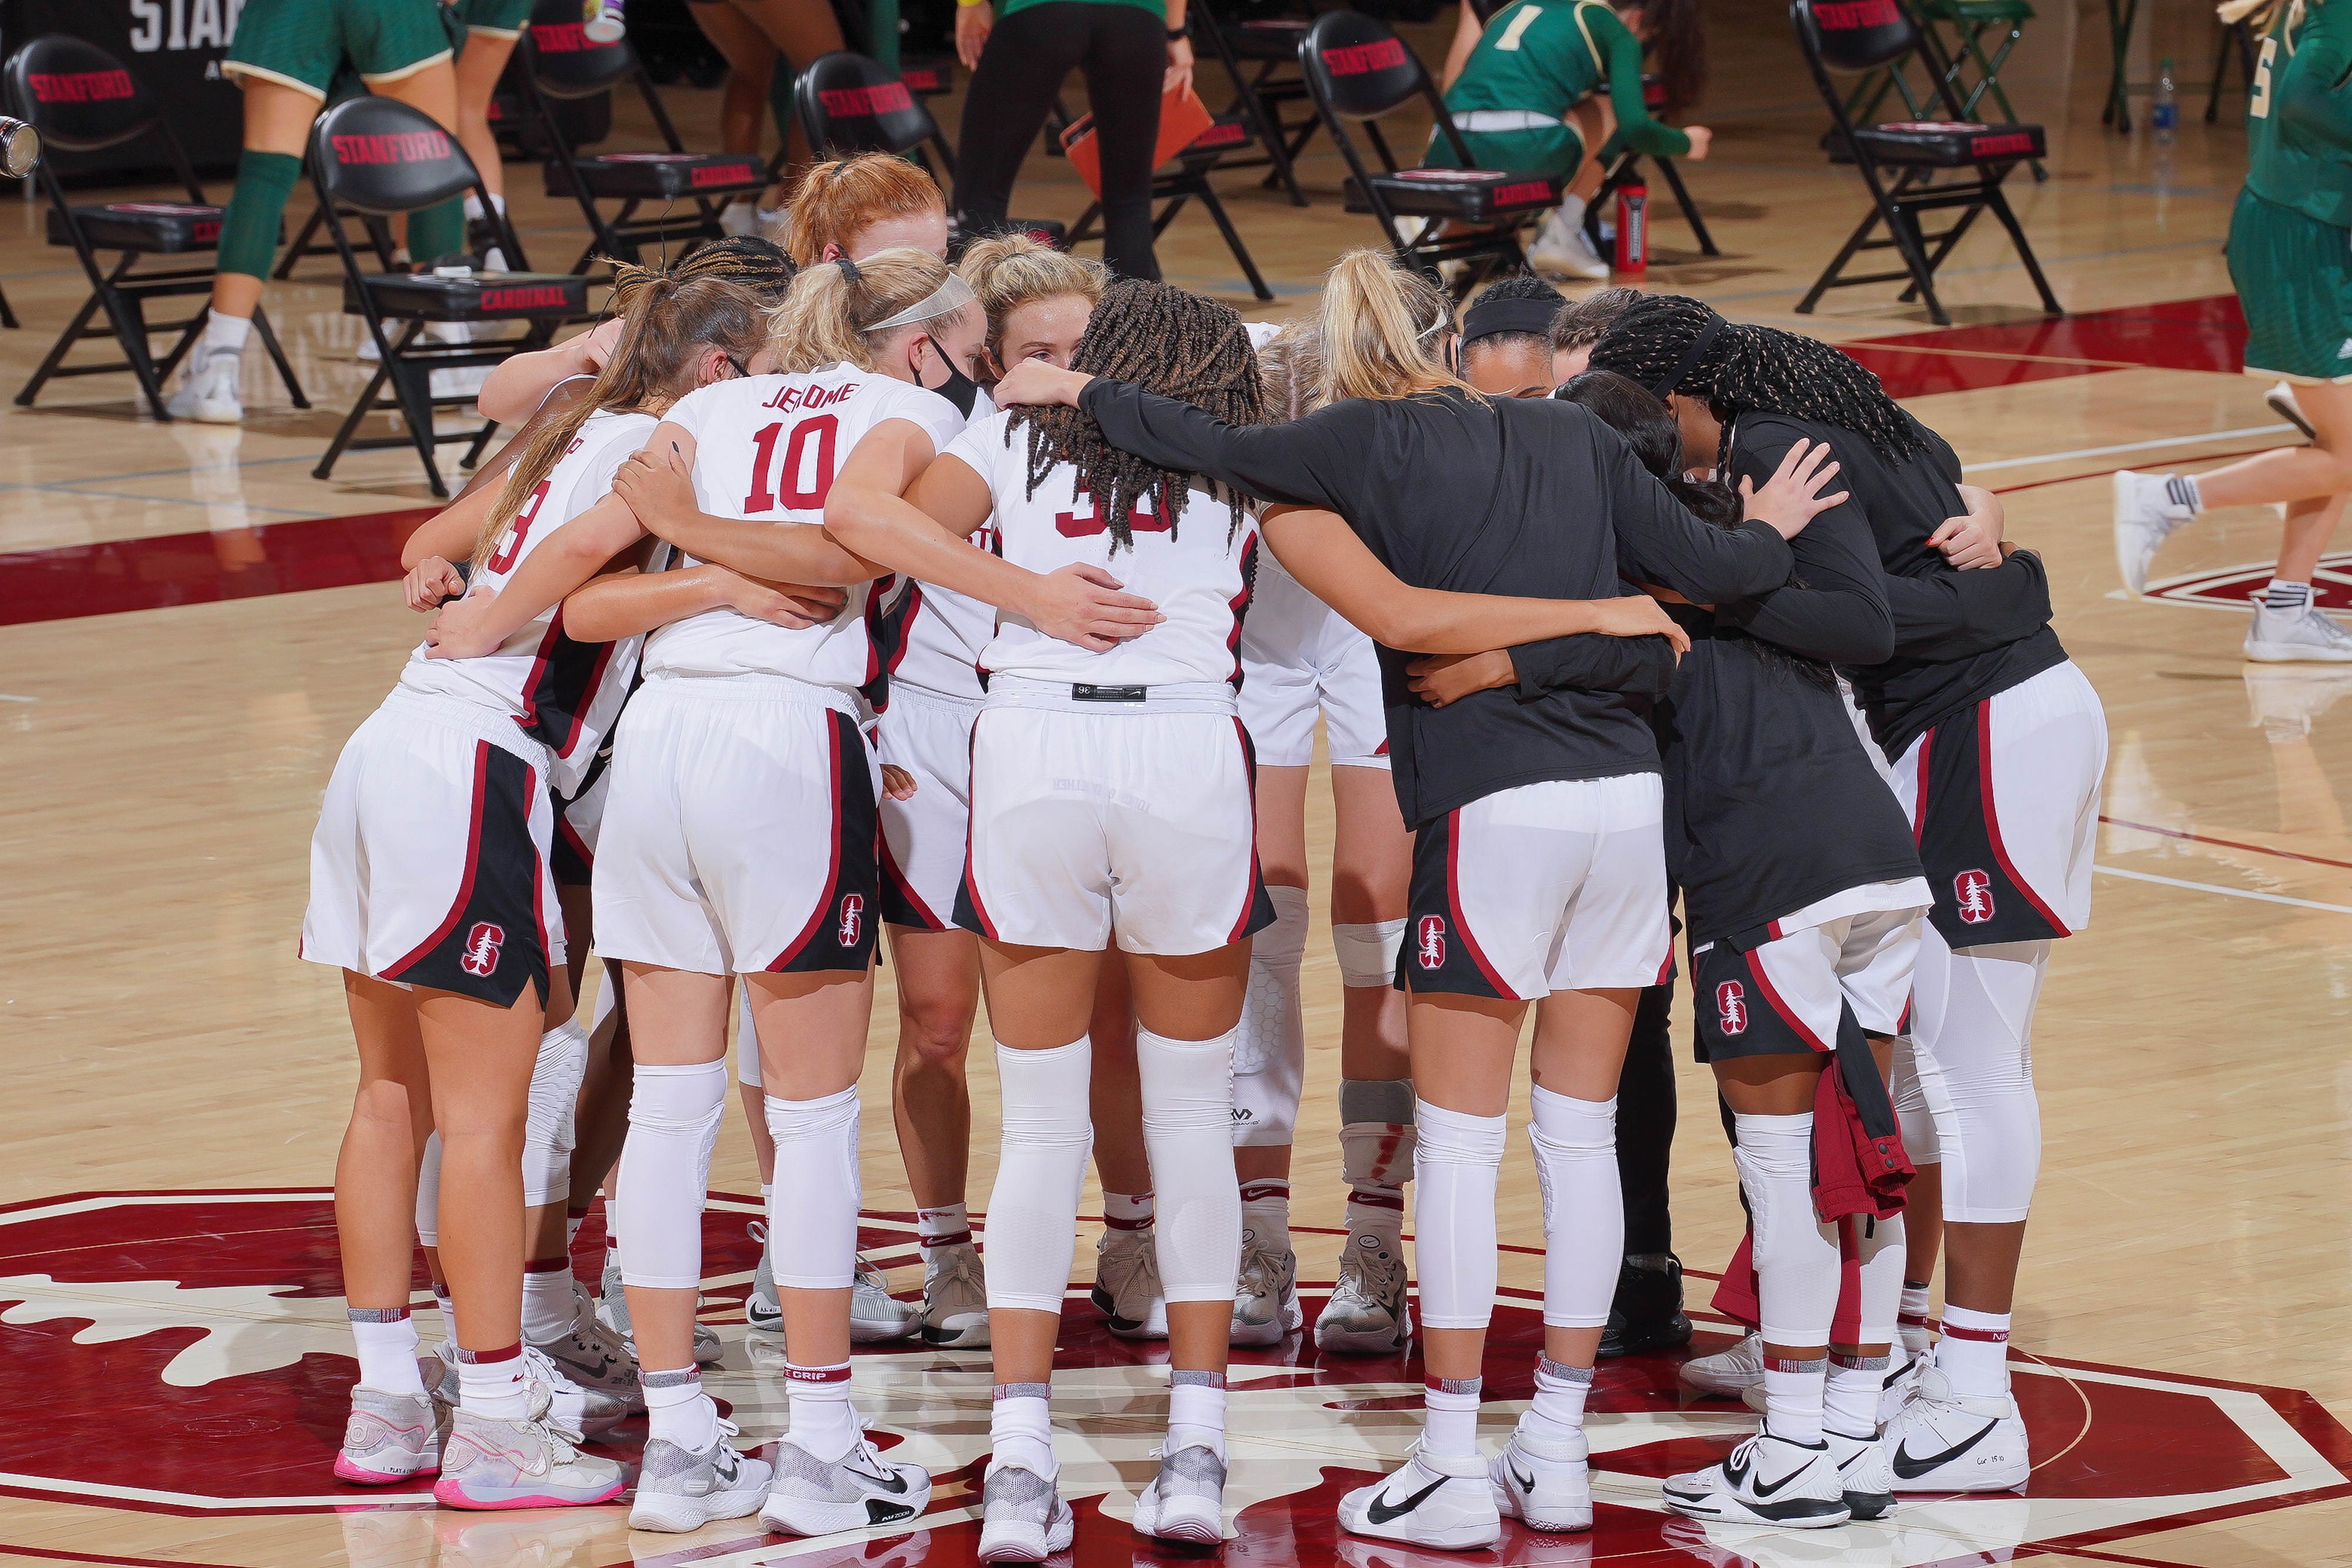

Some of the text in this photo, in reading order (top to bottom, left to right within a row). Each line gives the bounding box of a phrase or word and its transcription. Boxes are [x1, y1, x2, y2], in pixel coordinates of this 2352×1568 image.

[1494, 4, 1544, 51] 1
[28, 69, 135, 103] STANFORD
[2250, 36, 2278, 119] 5
[818, 81, 913, 117] STANFORD
[330, 129, 451, 164] STANFORD
[480, 286, 568, 311] CARDINAL
[744, 413, 839, 514] 10
[793, 1372, 826, 1380] GRIP
[894, 1510, 910, 1518] ZOOM
